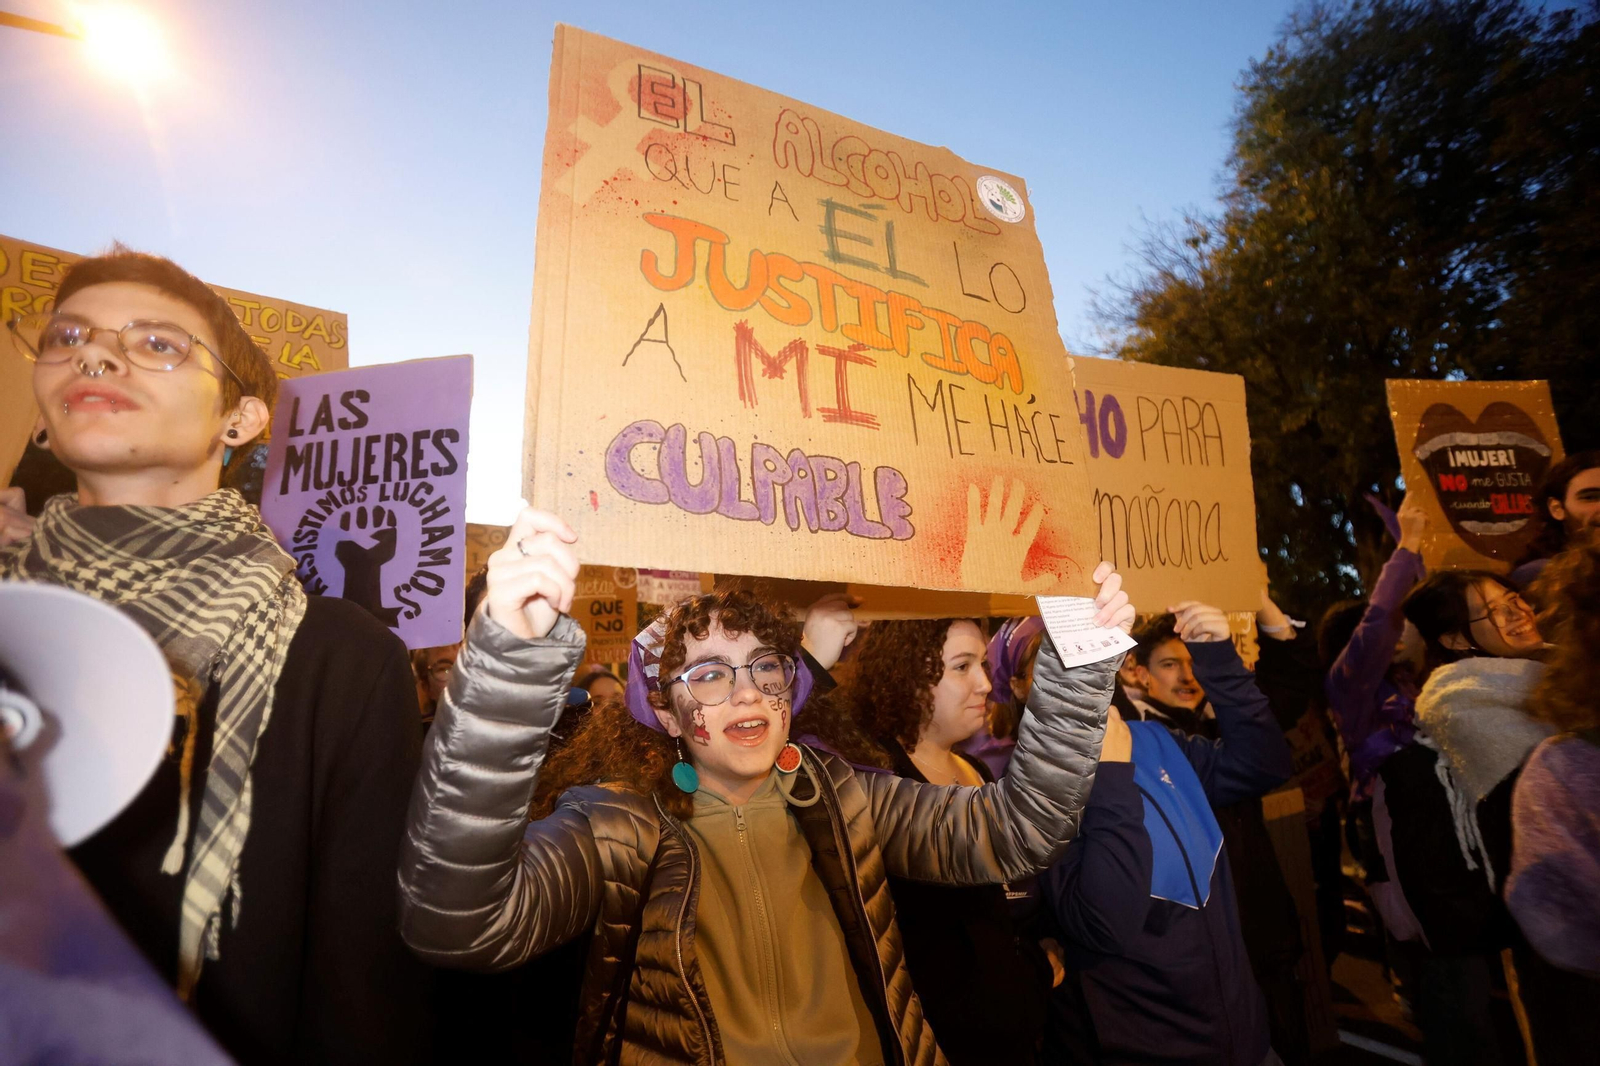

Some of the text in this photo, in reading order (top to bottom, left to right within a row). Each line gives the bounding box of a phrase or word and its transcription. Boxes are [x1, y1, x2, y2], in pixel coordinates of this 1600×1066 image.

[637, 64, 736, 146] EL
[773, 109, 1002, 236] ALCOHOL
[645, 143, 741, 202] QUE
[768, 181, 799, 222] A
[953, 241, 1027, 314] LO
[227, 297, 347, 349] TODAS
[640, 212, 1025, 395] JUSTIFICA
[278, 341, 320, 371] LA
[622, 302, 688, 384] A
[734, 319, 882, 432] MI
[908, 373, 975, 456] ME
[289, 390, 371, 438] LAS
[1136, 396, 1226, 467] PARA
[280, 428, 460, 495] MUJERES
[604, 418, 917, 542] CULPABLE
[1438, 473, 1469, 492] NO
[1494, 472, 1532, 487] GUSTA
[1447, 447, 1517, 469] ¡MUJER!
[378, 481, 455, 620] LUCHAMOS
[1093, 484, 1230, 571] mañana
[590, 600, 624, 617] QUE
[594, 618, 624, 632] NO
